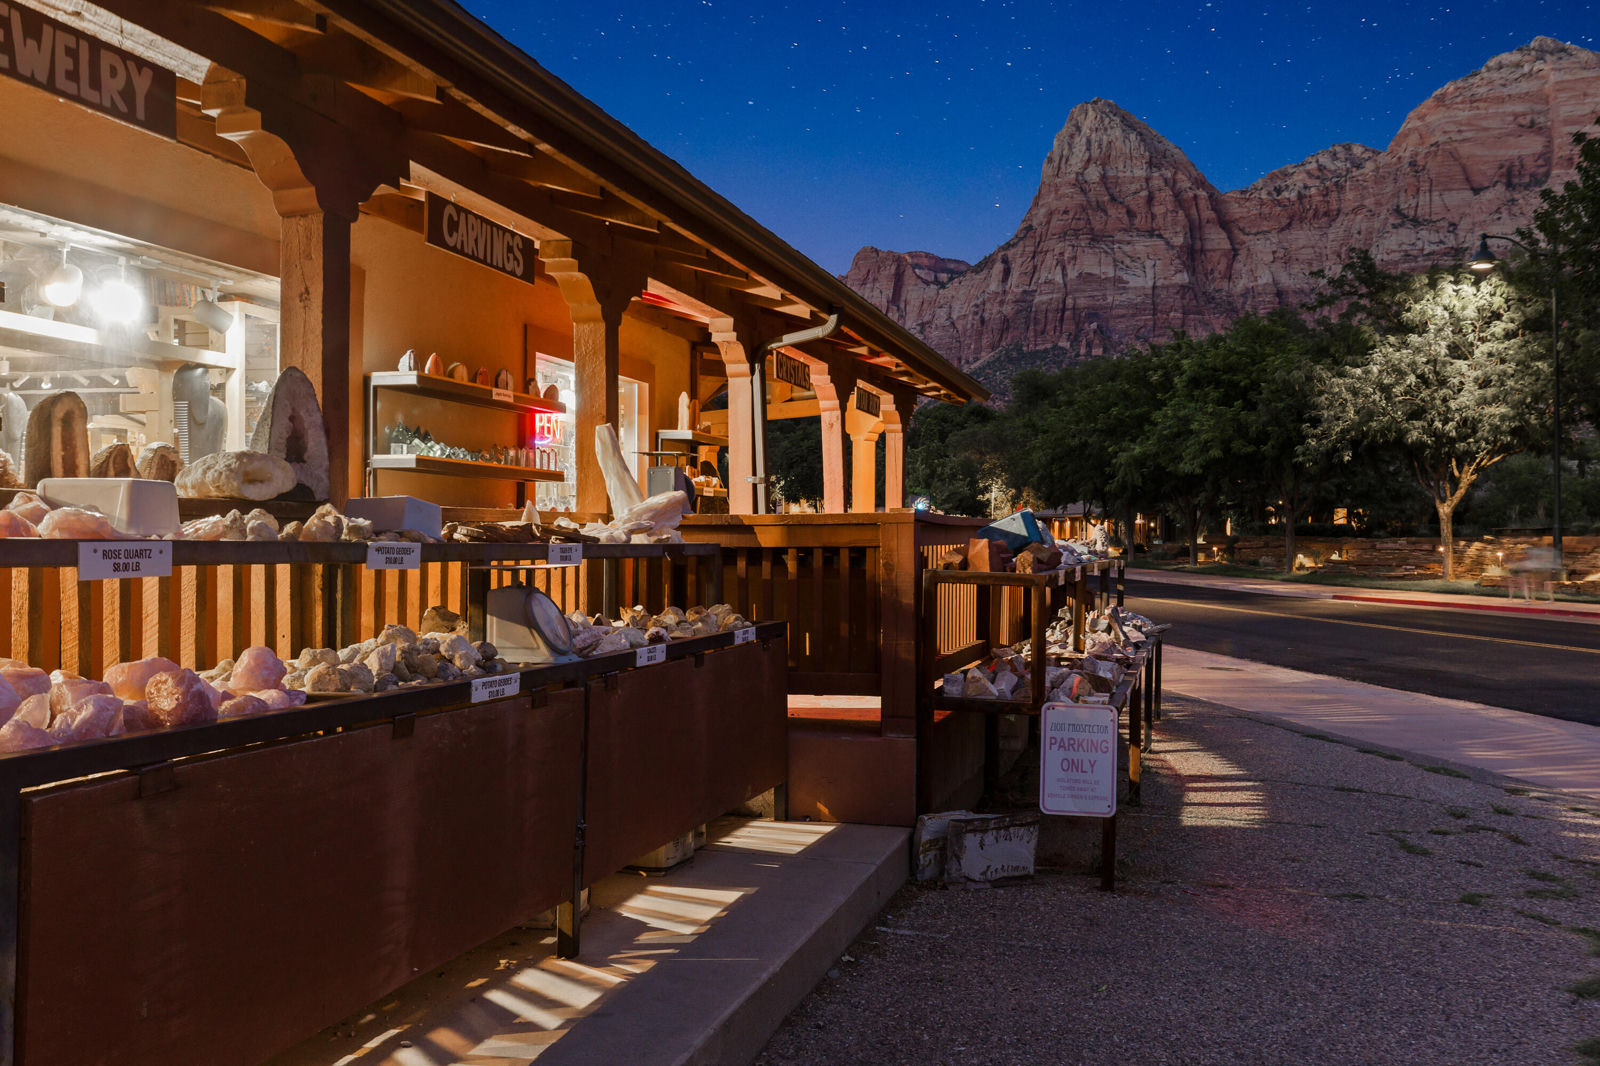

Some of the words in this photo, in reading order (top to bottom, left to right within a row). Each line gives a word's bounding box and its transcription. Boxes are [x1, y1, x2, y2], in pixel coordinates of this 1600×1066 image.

[442, 203, 524, 277] CARVINGS
[777, 353, 810, 389] CRYSTALS
[102, 549, 122, 560] ROSE
[123, 548, 153, 560] QUARTZ
[377, 546, 395, 555] POTATO
[396, 547, 412, 555] GEODES
[112, 562, 131, 573] $8.00
[131, 561, 141, 572] LB.
[481, 679, 498, 690] POTATO
[498, 677, 513, 687] GEODES
[1049, 736, 1110, 754] PARKING
[1060, 758, 1097, 774] ONLY
